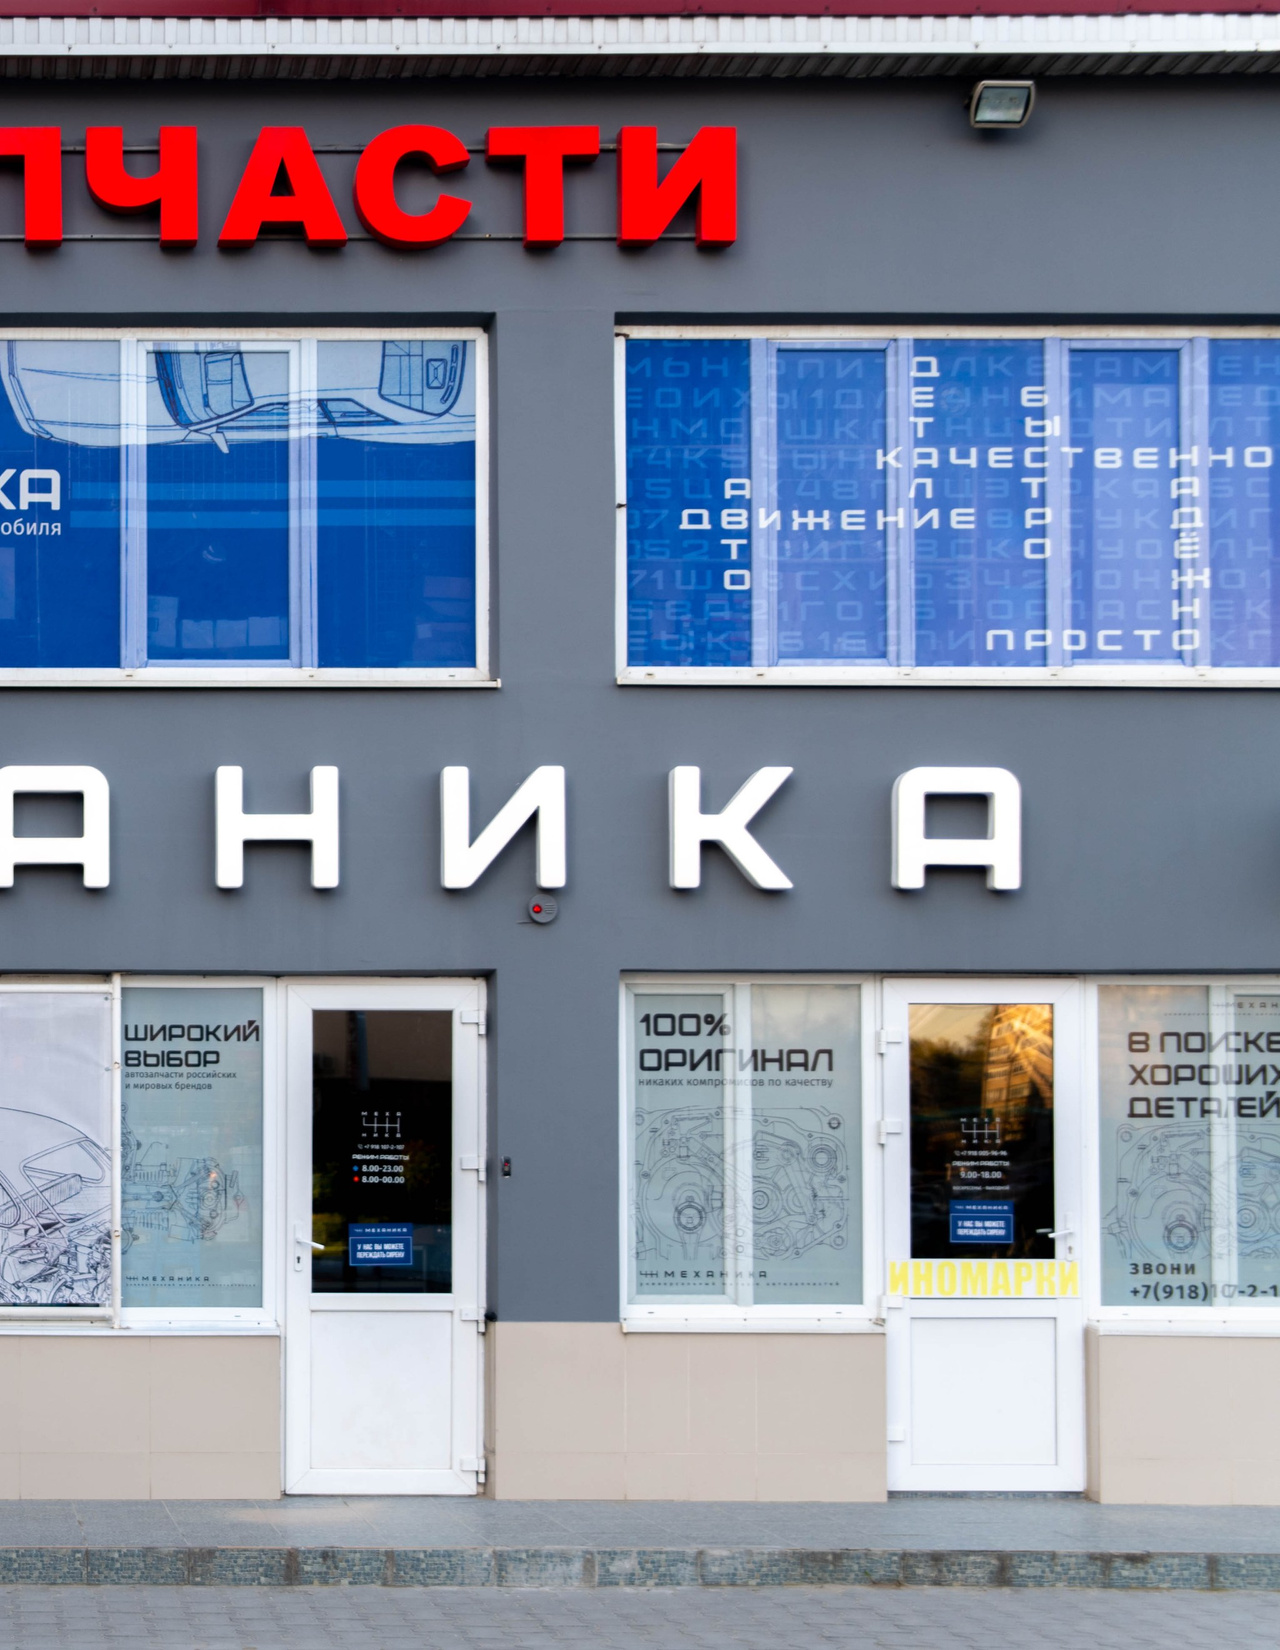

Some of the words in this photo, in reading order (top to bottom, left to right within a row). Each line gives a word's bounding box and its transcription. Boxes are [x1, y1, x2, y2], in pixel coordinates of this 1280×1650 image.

[876, 446, 1274, 470] КАЧЕСТВЕННО
[679, 508, 977, 532] ДВИЖЕНИЕ
[985, 629, 1202, 651] ПРОСТО
[124, 1020, 260, 1042] ШИРОКИЙ
[639, 1013, 731, 1037] 100%
[1128, 1031, 1150, 1053] В
[1159, 1031, 1280, 1053] ПОИСКЕ
[124, 1050, 220, 1068] ВЫБОР
[639, 1048, 834, 1072] ОРИГИНАЛ
[174, 1081, 213, 1091] брендов
[186, 1070, 237, 1080] российских
[638, 1078, 684, 1087] никаких
[768, 1079, 782, 1087] по
[784, 1078, 834, 1088] качеству
[1127, 1091, 1280, 1118] ДЕТАЛЕЙ
[888, 1261, 1080, 1296] ИНОМАРКИ
[1129, 1262, 1196, 1275] ЗВОНИ
